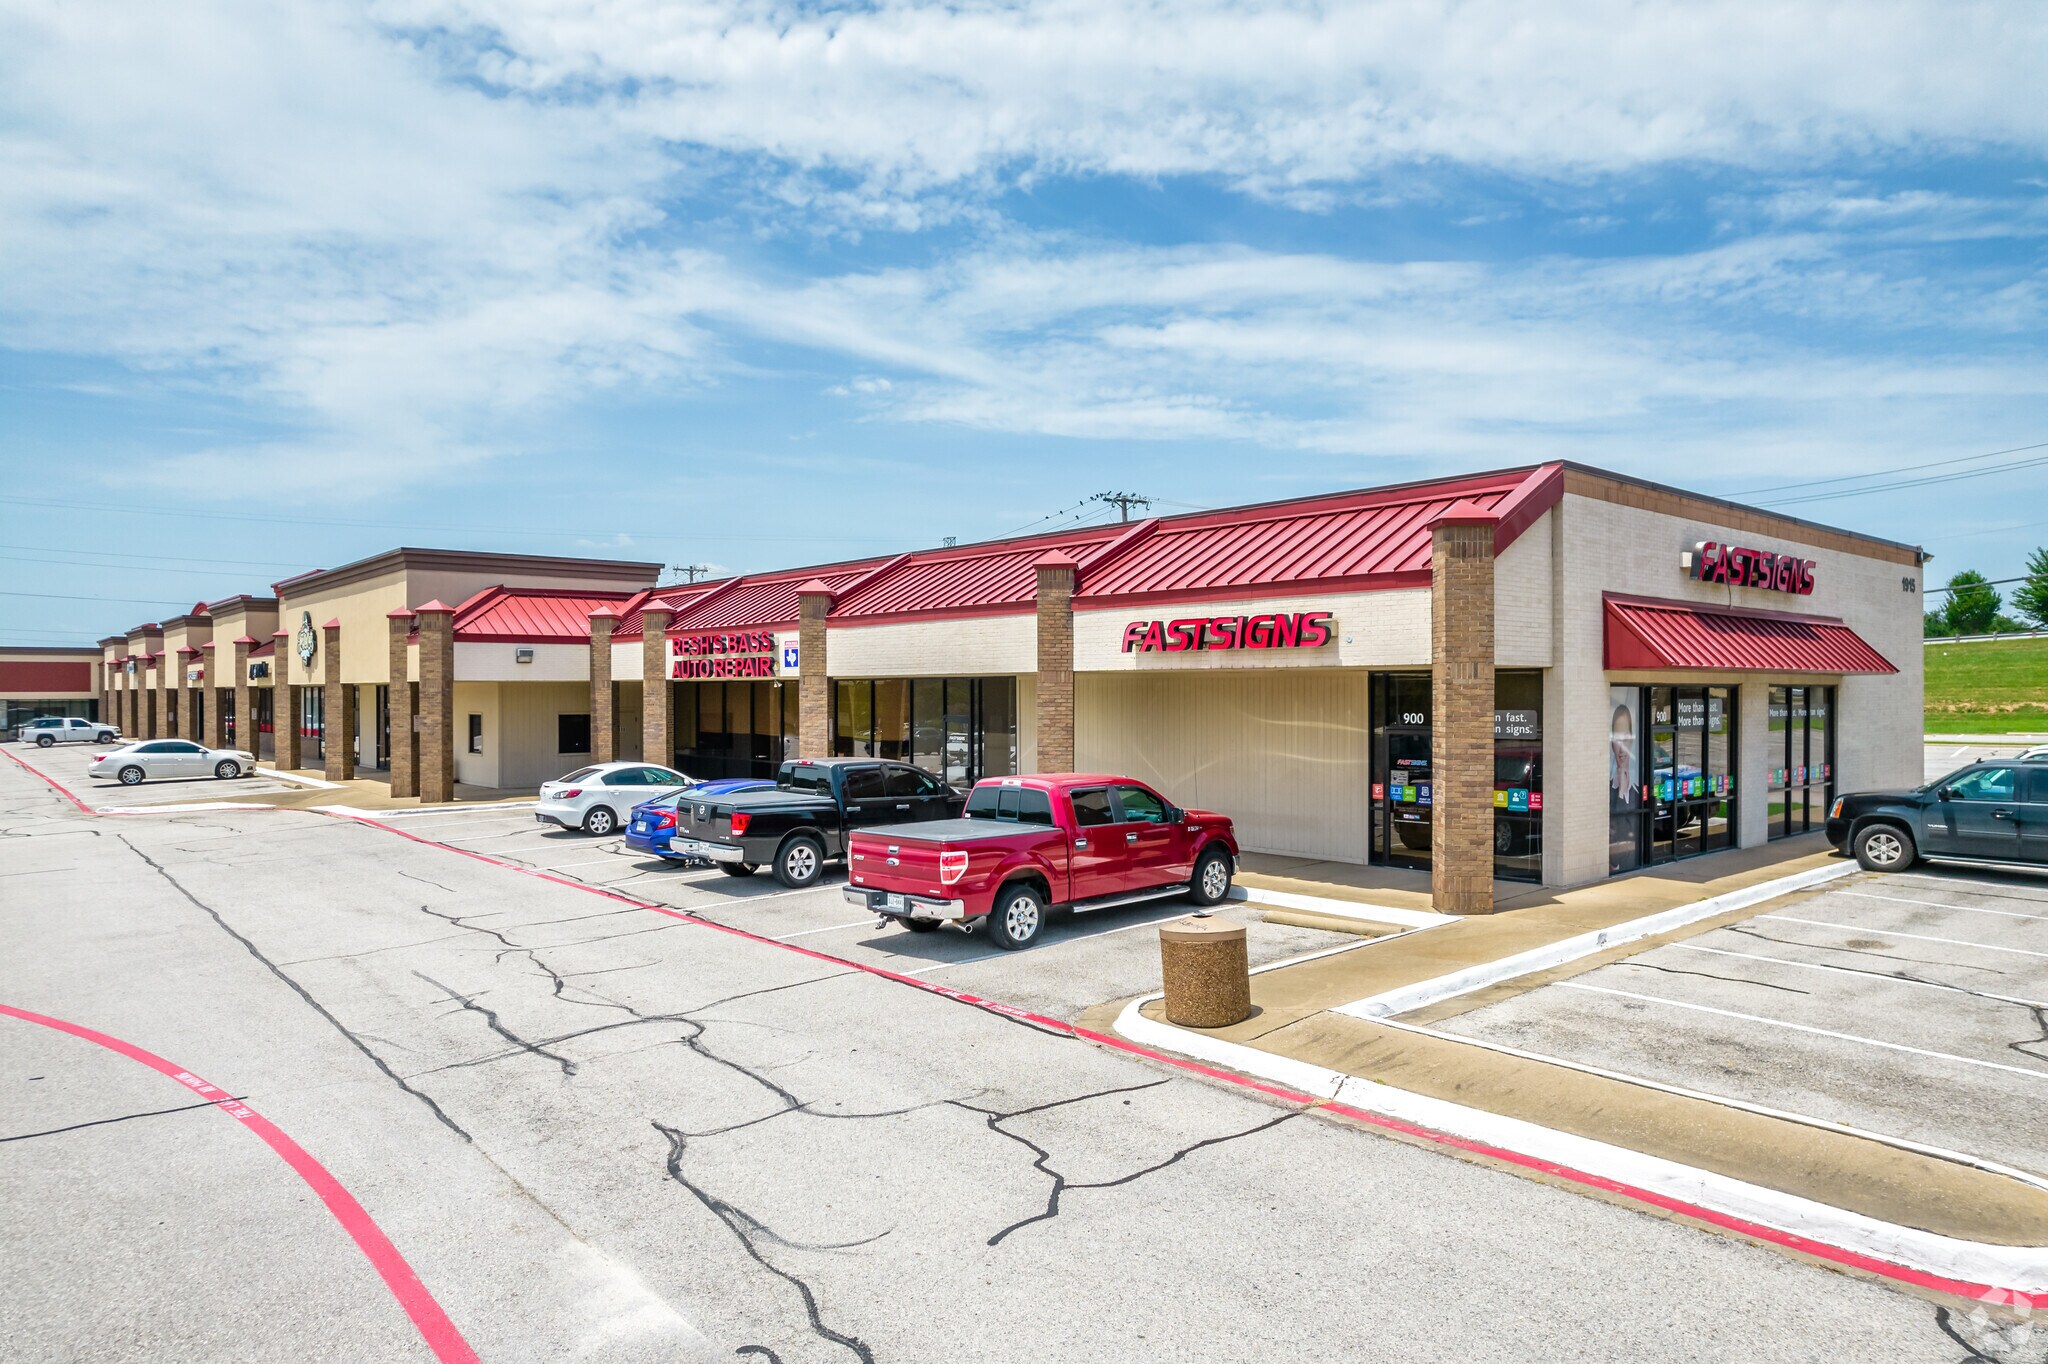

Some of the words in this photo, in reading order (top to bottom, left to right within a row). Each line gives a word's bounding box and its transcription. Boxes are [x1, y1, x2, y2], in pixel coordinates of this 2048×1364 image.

[1697, 541, 1817, 596] FASTSIGNS
[1901, 576, 1916, 593] 1915
[1121, 611, 1333, 653] FASTSIGNS
[672, 634, 725, 656] RESH'S
[727, 631, 773, 653] BASS
[672, 658, 711, 678] AUTO
[714, 657, 774, 678] REPAIR
[1678, 702, 1692, 712] More
[1692, 701, 1705, 712] than
[1403, 713, 1424, 725] 900
[1505, 712, 1527, 722] fast.
[1656, 711, 1667, 722] 900
[1678, 715, 1692, 726] More
[1692, 714, 1705, 726] than
